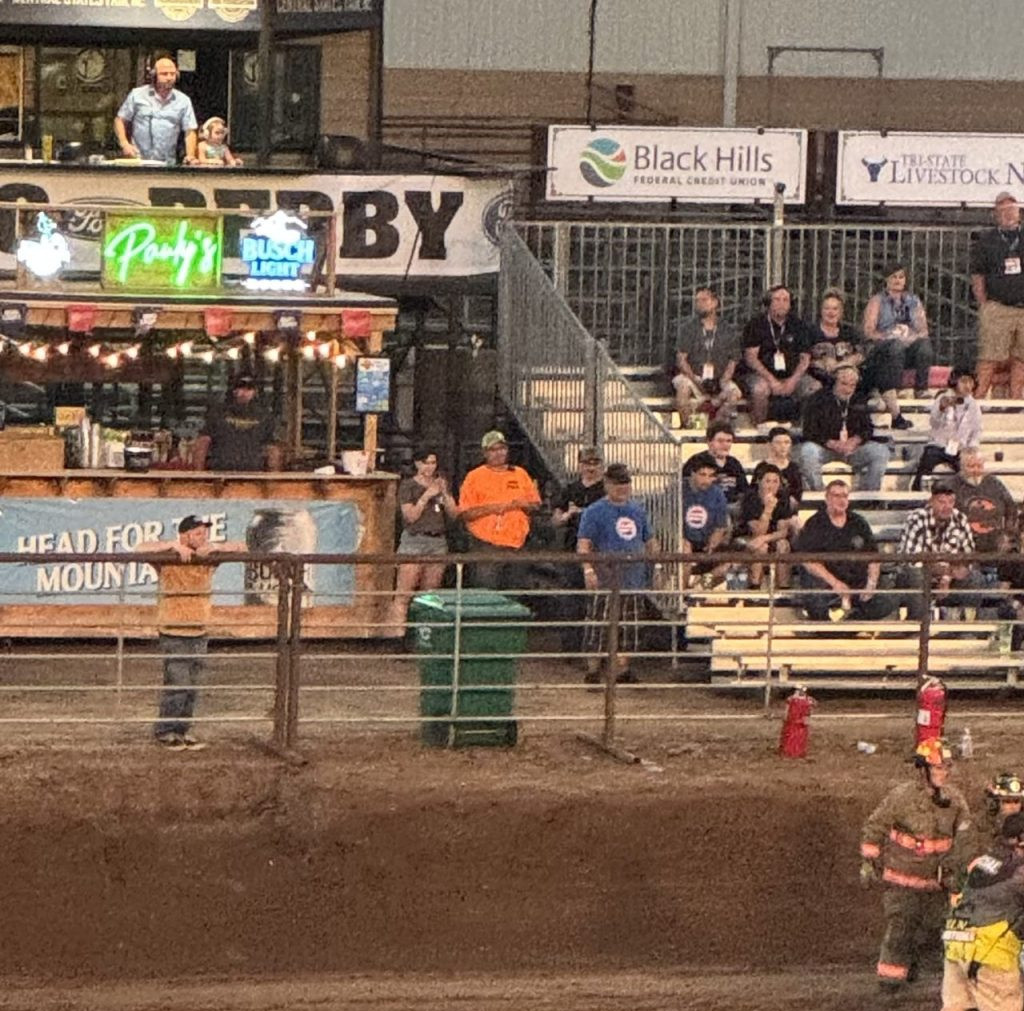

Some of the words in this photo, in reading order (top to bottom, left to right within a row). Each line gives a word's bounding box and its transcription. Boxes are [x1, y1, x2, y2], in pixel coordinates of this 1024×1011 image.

[634, 145, 708, 171] Black
[716, 146, 773, 172] Hills
[902, 154, 967, 169] TRI-STATE
[634, 175, 682, 185] FEDERAL
[687, 176, 726, 185] CREDIT
[730, 177, 766, 186] UNION
[889, 160, 1000, 185] LIVESTOCK
[242, 237, 315, 262] BUSCH
[251, 261, 301, 277] LIGHT
[17, 533, 99, 554] HEAD
[106, 521, 165, 551] FOR
[172, 512, 229, 543] TE
